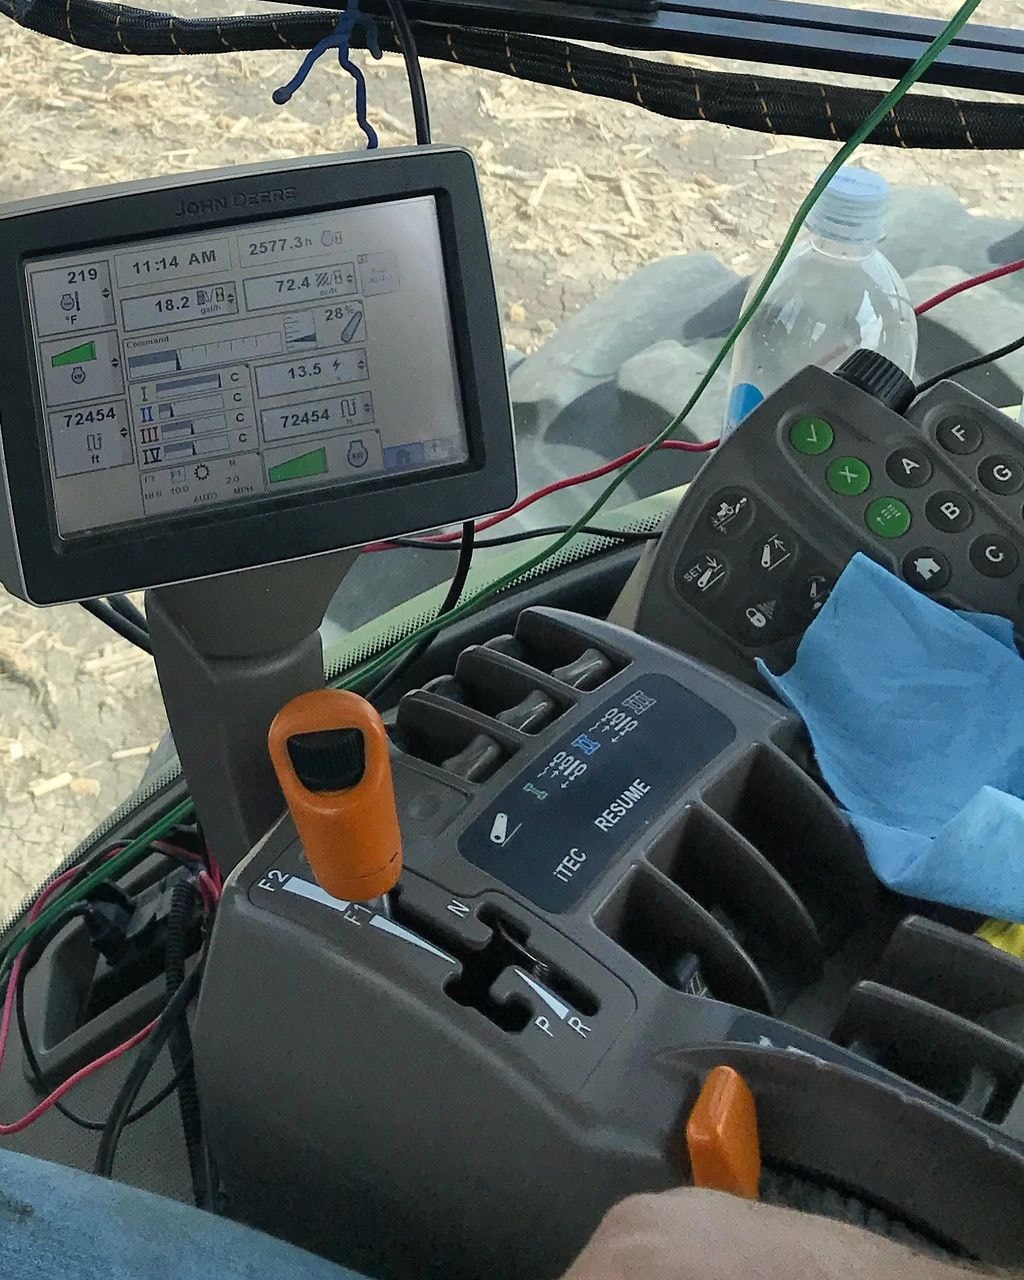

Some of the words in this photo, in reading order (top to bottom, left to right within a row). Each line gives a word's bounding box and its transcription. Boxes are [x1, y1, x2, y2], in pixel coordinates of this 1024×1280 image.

[176, 196, 228, 217] JOHN
[233, 186, 296, 207] DEERE
[133, 256, 179, 274] 11:14
[188, 250, 217, 266] AM
[68, 268, 98, 284] 219
[276, 276, 311, 293] 72.4
[155, 296, 190, 313] 18.2
[200, 304, 222, 315] gal/h
[126, 336, 169, 350] Command
[231, 372, 240, 381] C
[288, 362, 322, 379] 13.5
[234, 393, 242, 401] C
[64, 407, 116, 427] 72454
[280, 409, 330, 428] 72454
[140, 426, 160, 444] III
[236, 413, 245, 422] C
[950, 424, 967, 442] F
[142, 447, 162, 465] IV
[239, 433, 247, 442] C
[91, 455, 100, 464] ft
[900, 457, 920, 475] A
[993, 464, 1012, 482] G
[171, 486, 189, 494] 10.0
[194, 493, 217, 502] AUTO
[234, 486, 254, 494] MPH
[940, 501, 960, 520] B
[985, 544, 1004, 563] C
[684, 563, 703, 583] SET
[594, 778, 652, 832] RESUME
[553, 847, 587, 883] iTEC
[258, 869, 290, 893] F2
[343, 902, 372, 926] F1
[447, 899, 471, 918] N
[535, 1016, 555, 1037] P
[567, 1016, 592, 1038] R
